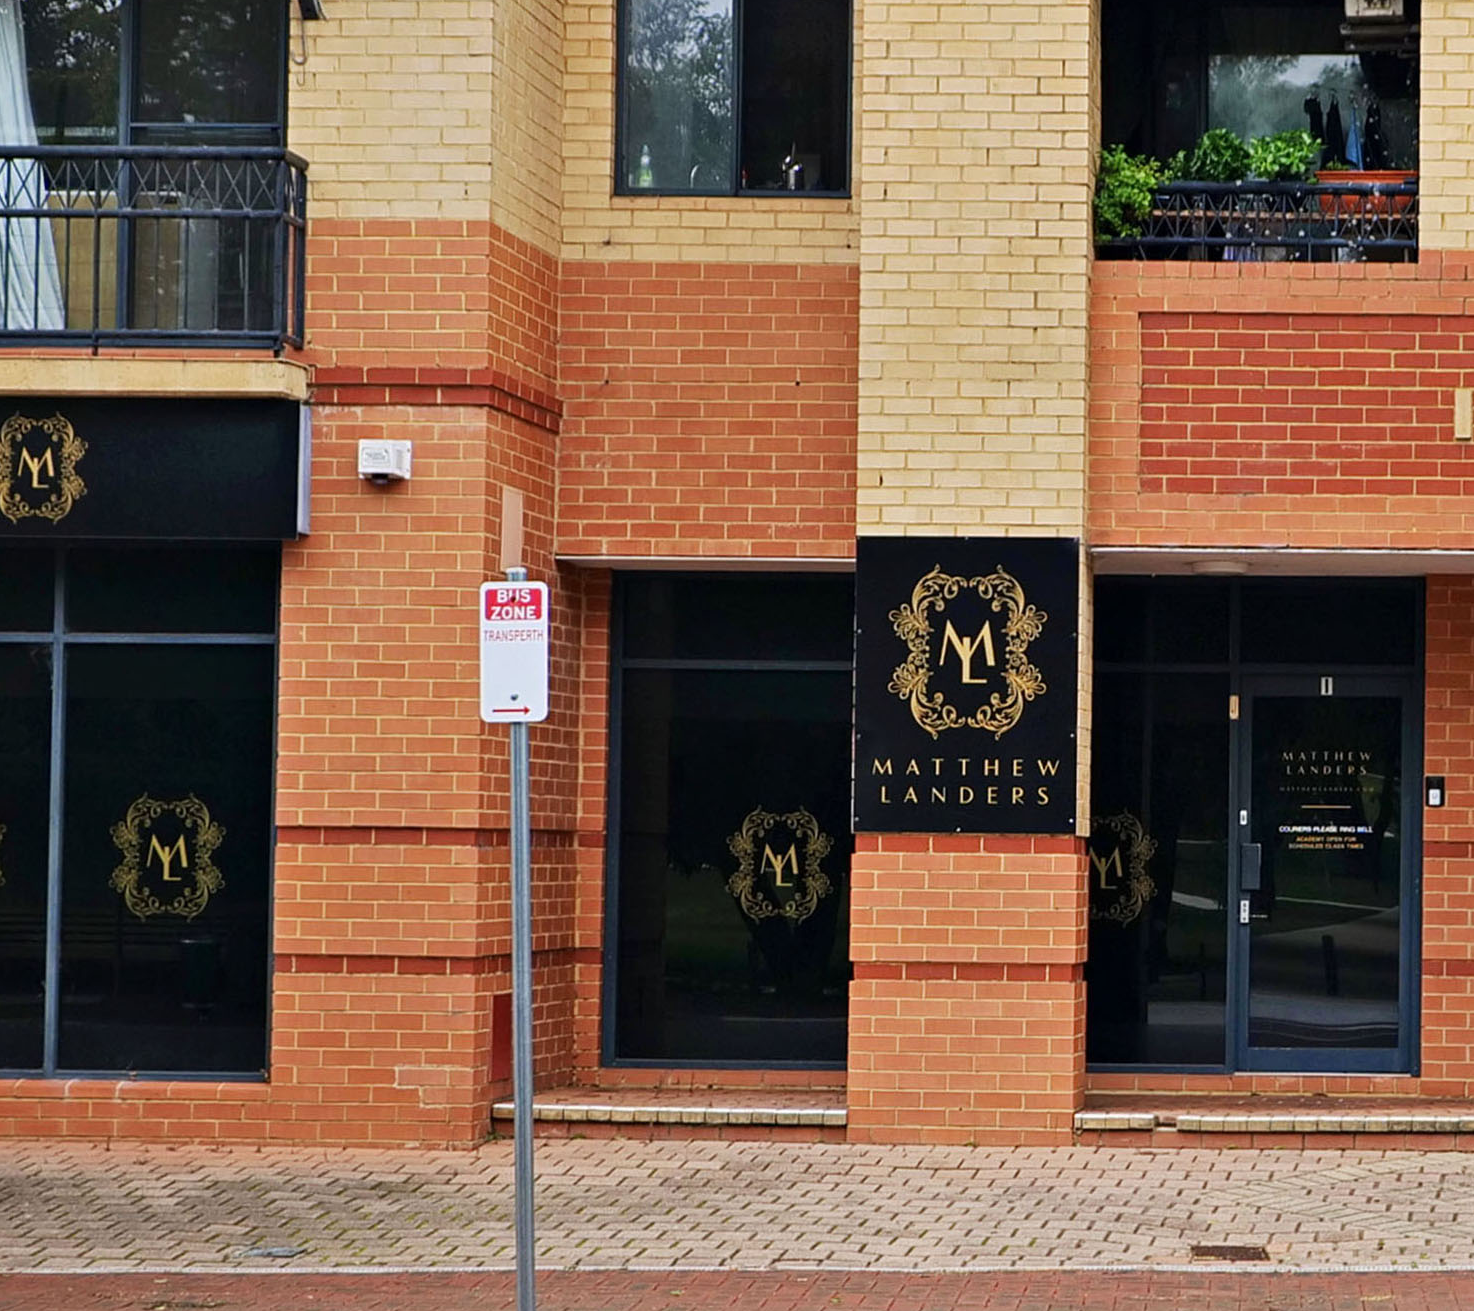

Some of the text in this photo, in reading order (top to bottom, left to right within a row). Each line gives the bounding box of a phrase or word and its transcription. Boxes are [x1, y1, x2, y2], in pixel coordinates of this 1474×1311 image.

[497, 589, 531, 603] BUS
[490, 606, 536, 620] ZONE
[484, 630, 543, 641] TRANSPERTH
[1282, 751, 1371, 761] MATTHEW
[871, 757, 1060, 777] MATTHEW
[1286, 765, 1367, 775] LANDERS
[881, 786, 1050, 805] LANDERS
